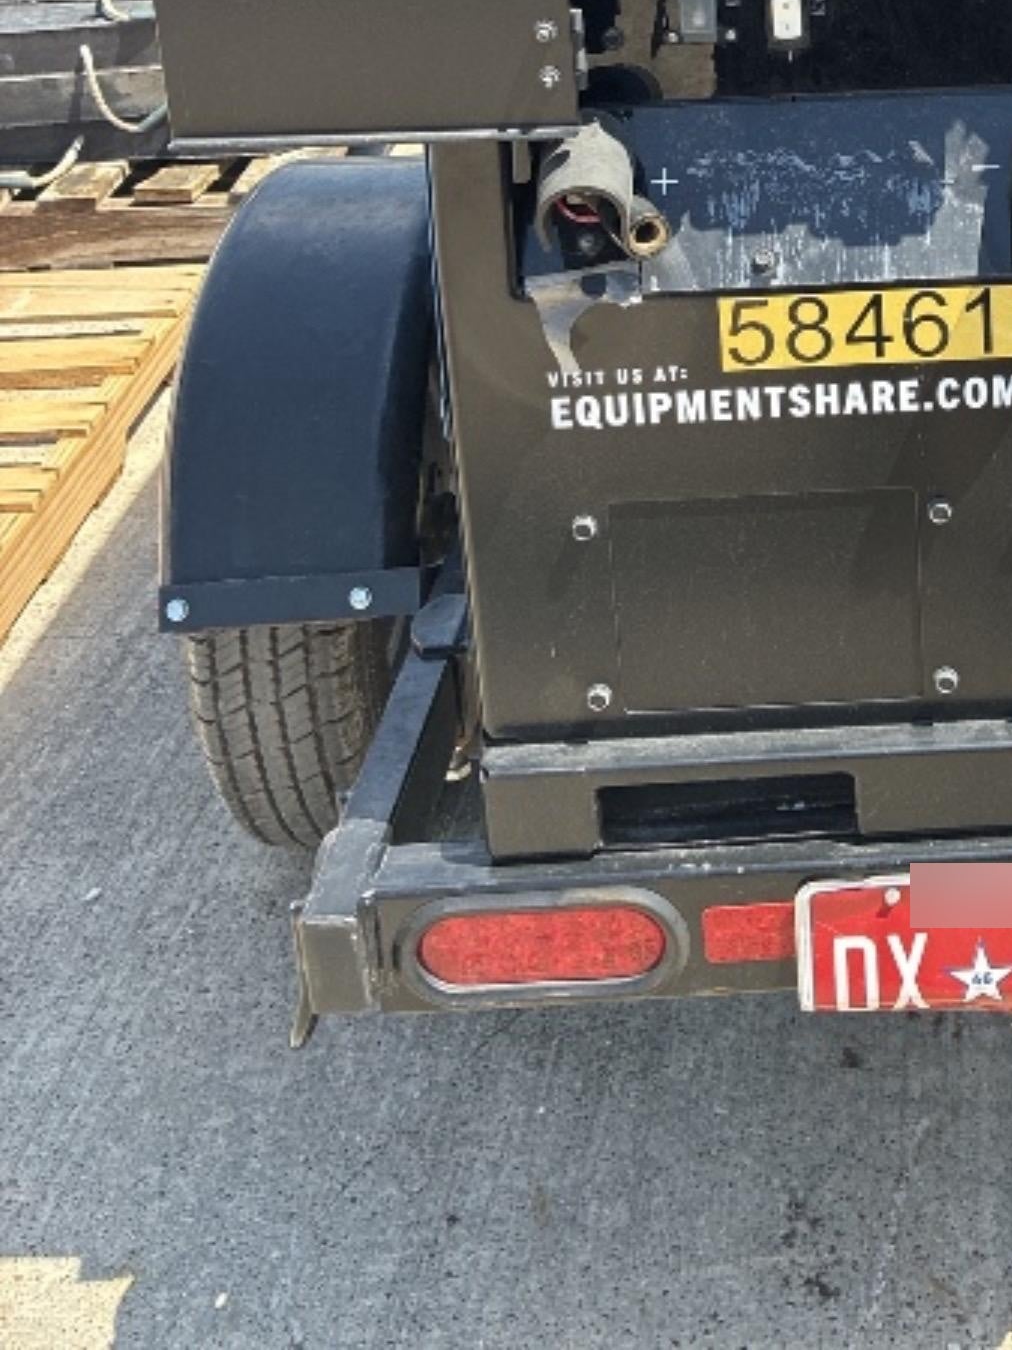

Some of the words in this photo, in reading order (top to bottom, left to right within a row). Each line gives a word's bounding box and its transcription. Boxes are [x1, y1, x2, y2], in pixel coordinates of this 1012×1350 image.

[547, 368, 606, 388] VISIT
[616, 368, 643, 385] US
[653, 366, 689, 383] AT:
